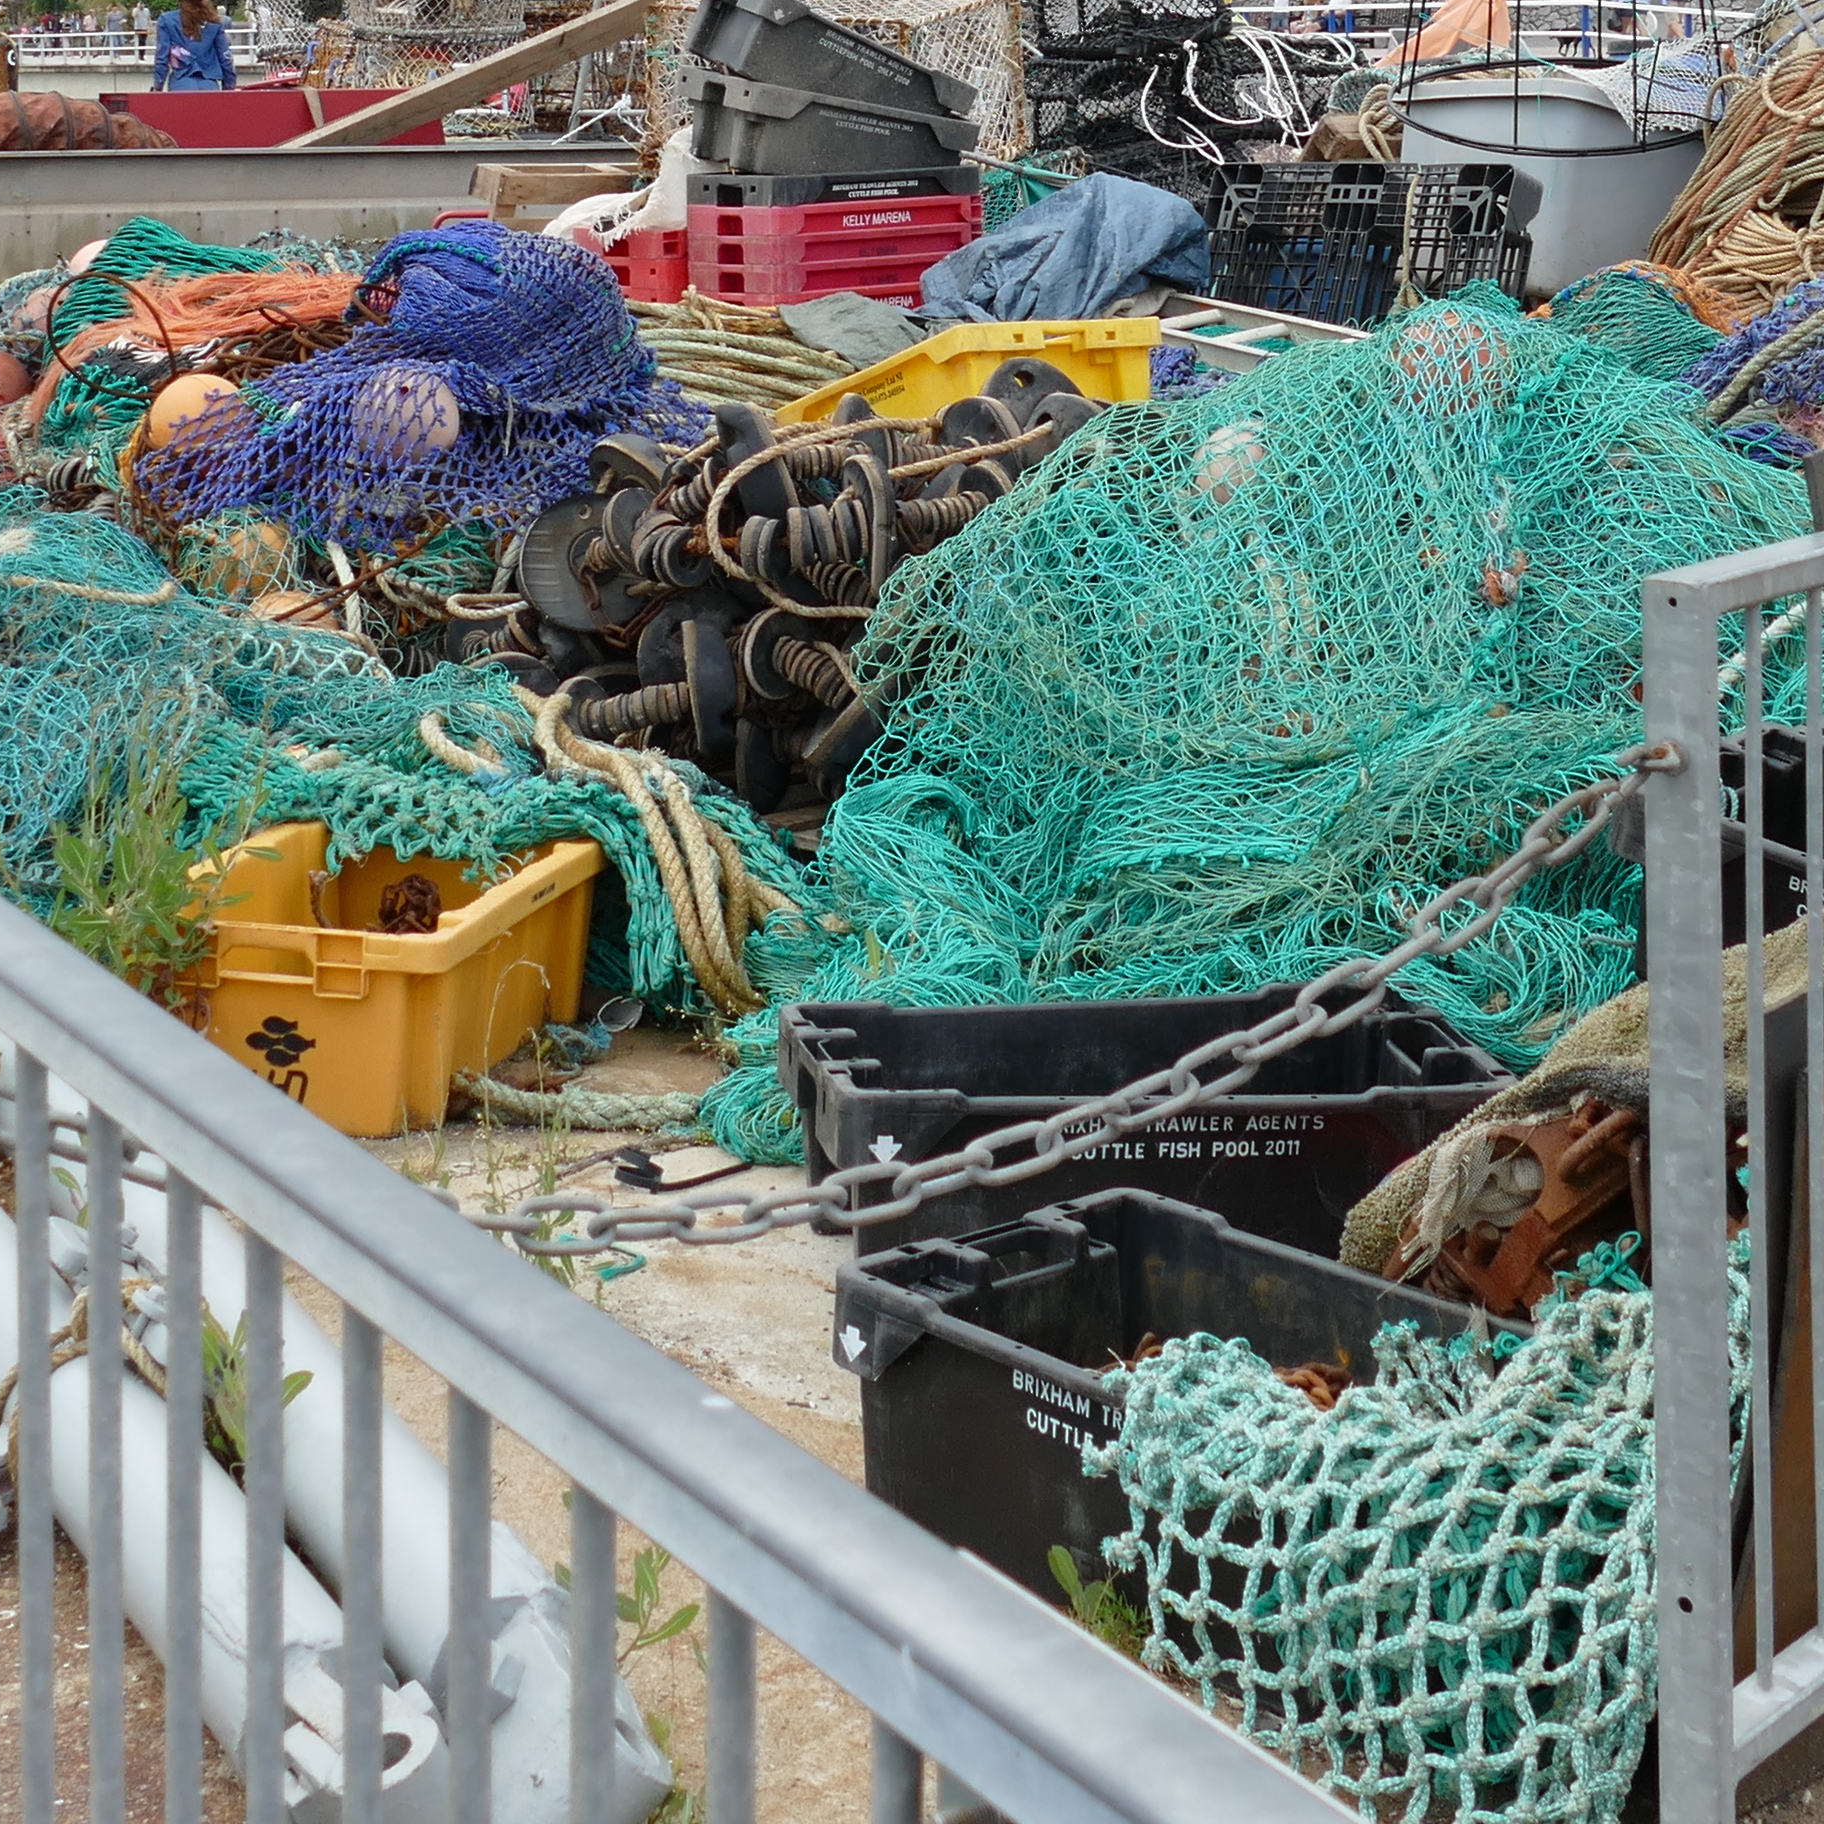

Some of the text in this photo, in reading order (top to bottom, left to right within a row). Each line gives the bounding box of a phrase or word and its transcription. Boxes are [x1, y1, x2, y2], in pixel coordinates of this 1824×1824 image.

[842, 210, 912, 227] KELLY MARENA
[1246, 1114, 1325, 1131] AGENTS
[1158, 1141, 1201, 1159] FISH
[1212, 1140, 1259, 1158] POOL
[1265, 1139, 1301, 1156] 2011
[1013, 1368, 1090, 1419] BRIXHAM
